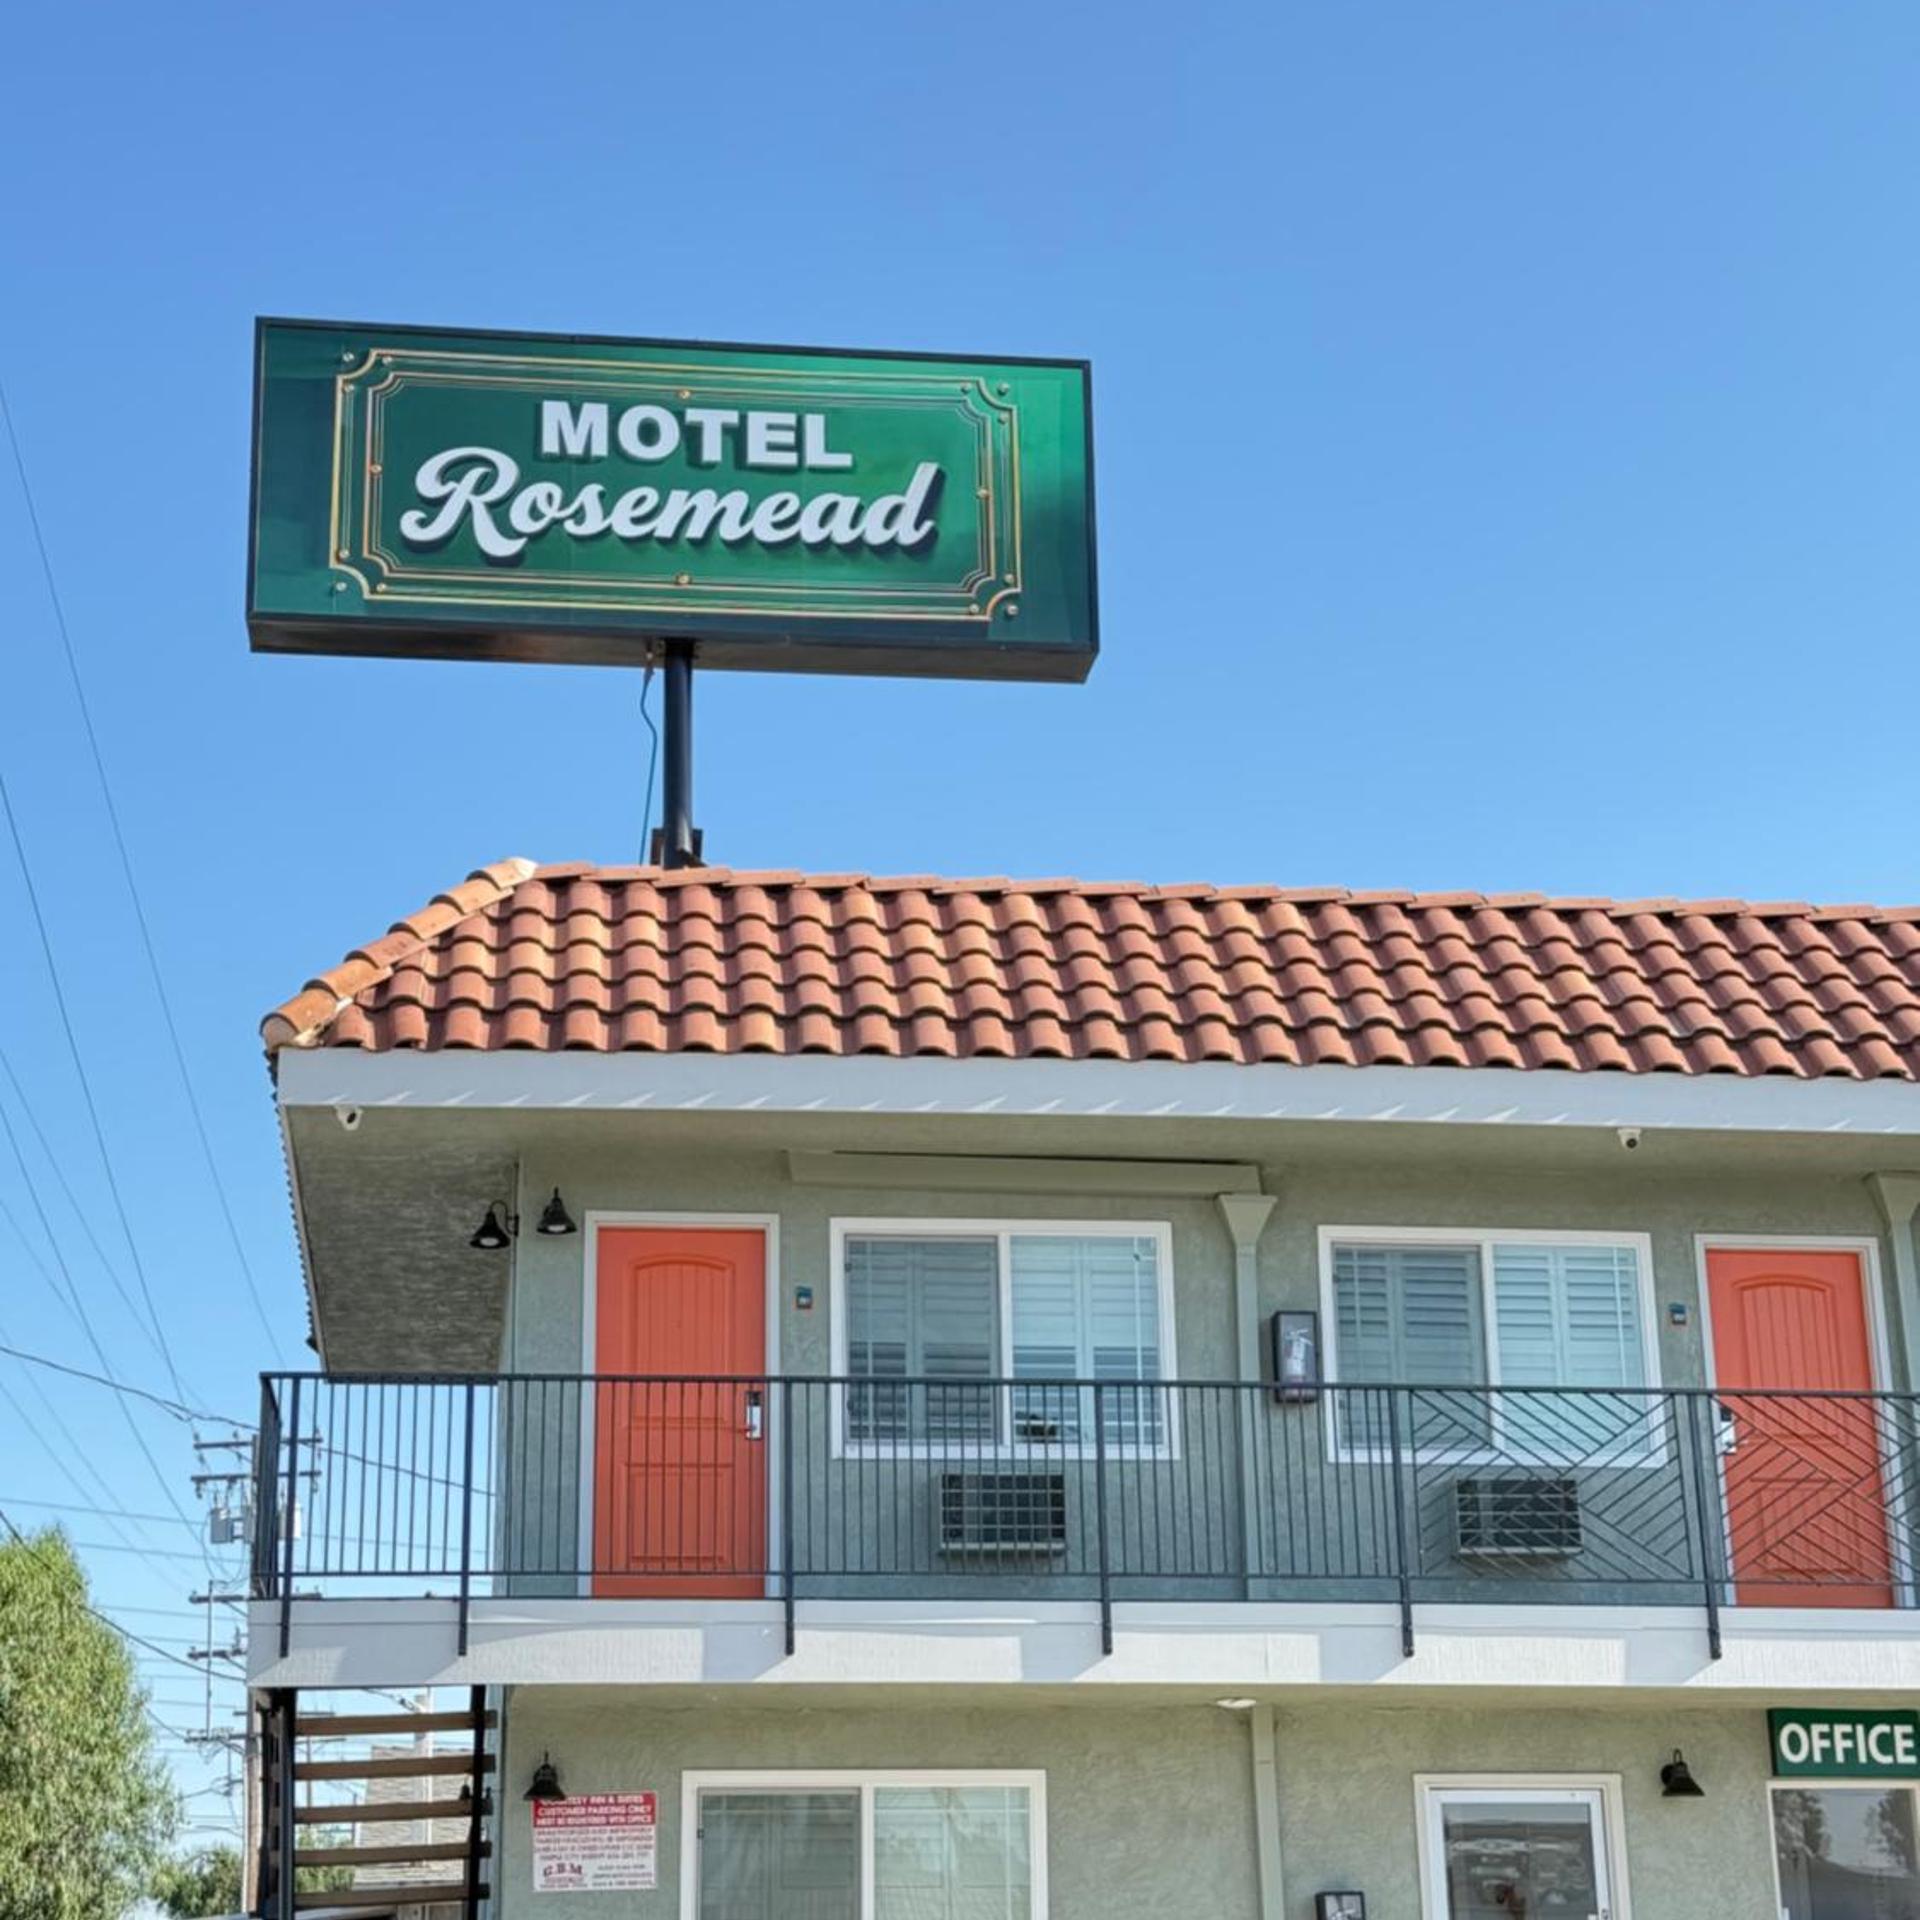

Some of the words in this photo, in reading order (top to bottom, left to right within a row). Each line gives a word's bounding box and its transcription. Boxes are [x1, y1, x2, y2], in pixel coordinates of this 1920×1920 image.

[540, 399, 853, 468] MOTEL
[399, 446, 939, 558] Rosemead
[1779, 1722, 1918, 1764] OFFICE
[537, 1805, 586, 1816] CUSTOMER
